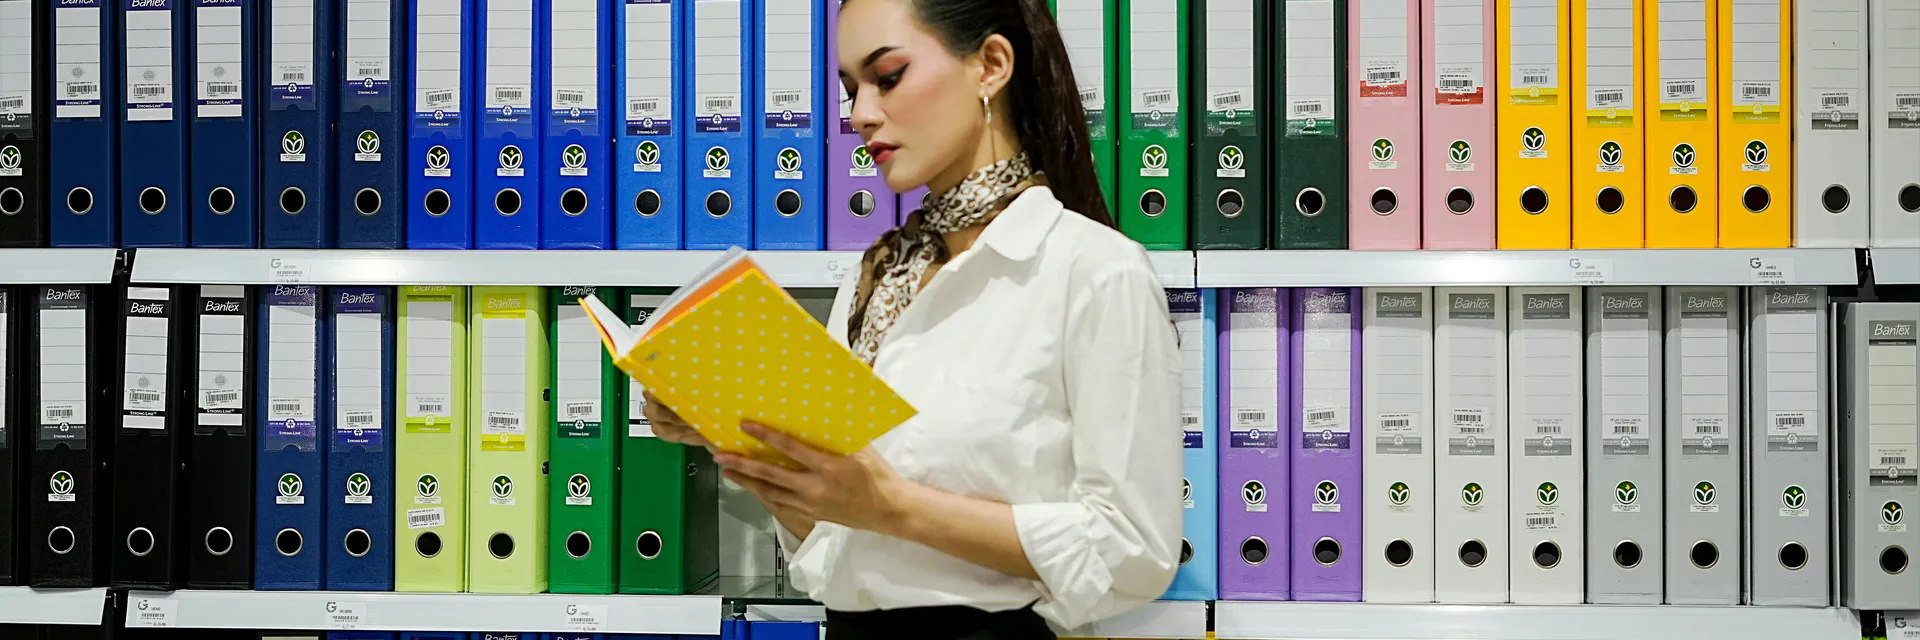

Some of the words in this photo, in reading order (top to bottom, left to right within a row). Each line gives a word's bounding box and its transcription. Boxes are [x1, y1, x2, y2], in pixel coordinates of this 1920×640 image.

[46, 289, 81, 300] Bantex
[274, 285, 311, 296] Bantex
[563, 285, 596, 296] Bantex
[340, 292, 376, 304] Bantex
[487, 297, 522, 309] Bantex
[1381, 296, 1417, 308] Bantex
[1454, 297, 1490, 309] Bantex
[1527, 297, 1564, 309] Bantex
[1606, 297, 1643, 309] Bantex
[1687, 296, 1724, 308] Bantex
[1772, 292, 1809, 304] Bantex
[130, 302, 165, 314] Bantex
[205, 300, 240, 312] Bantex
[1874, 324, 1912, 336] Bantex
